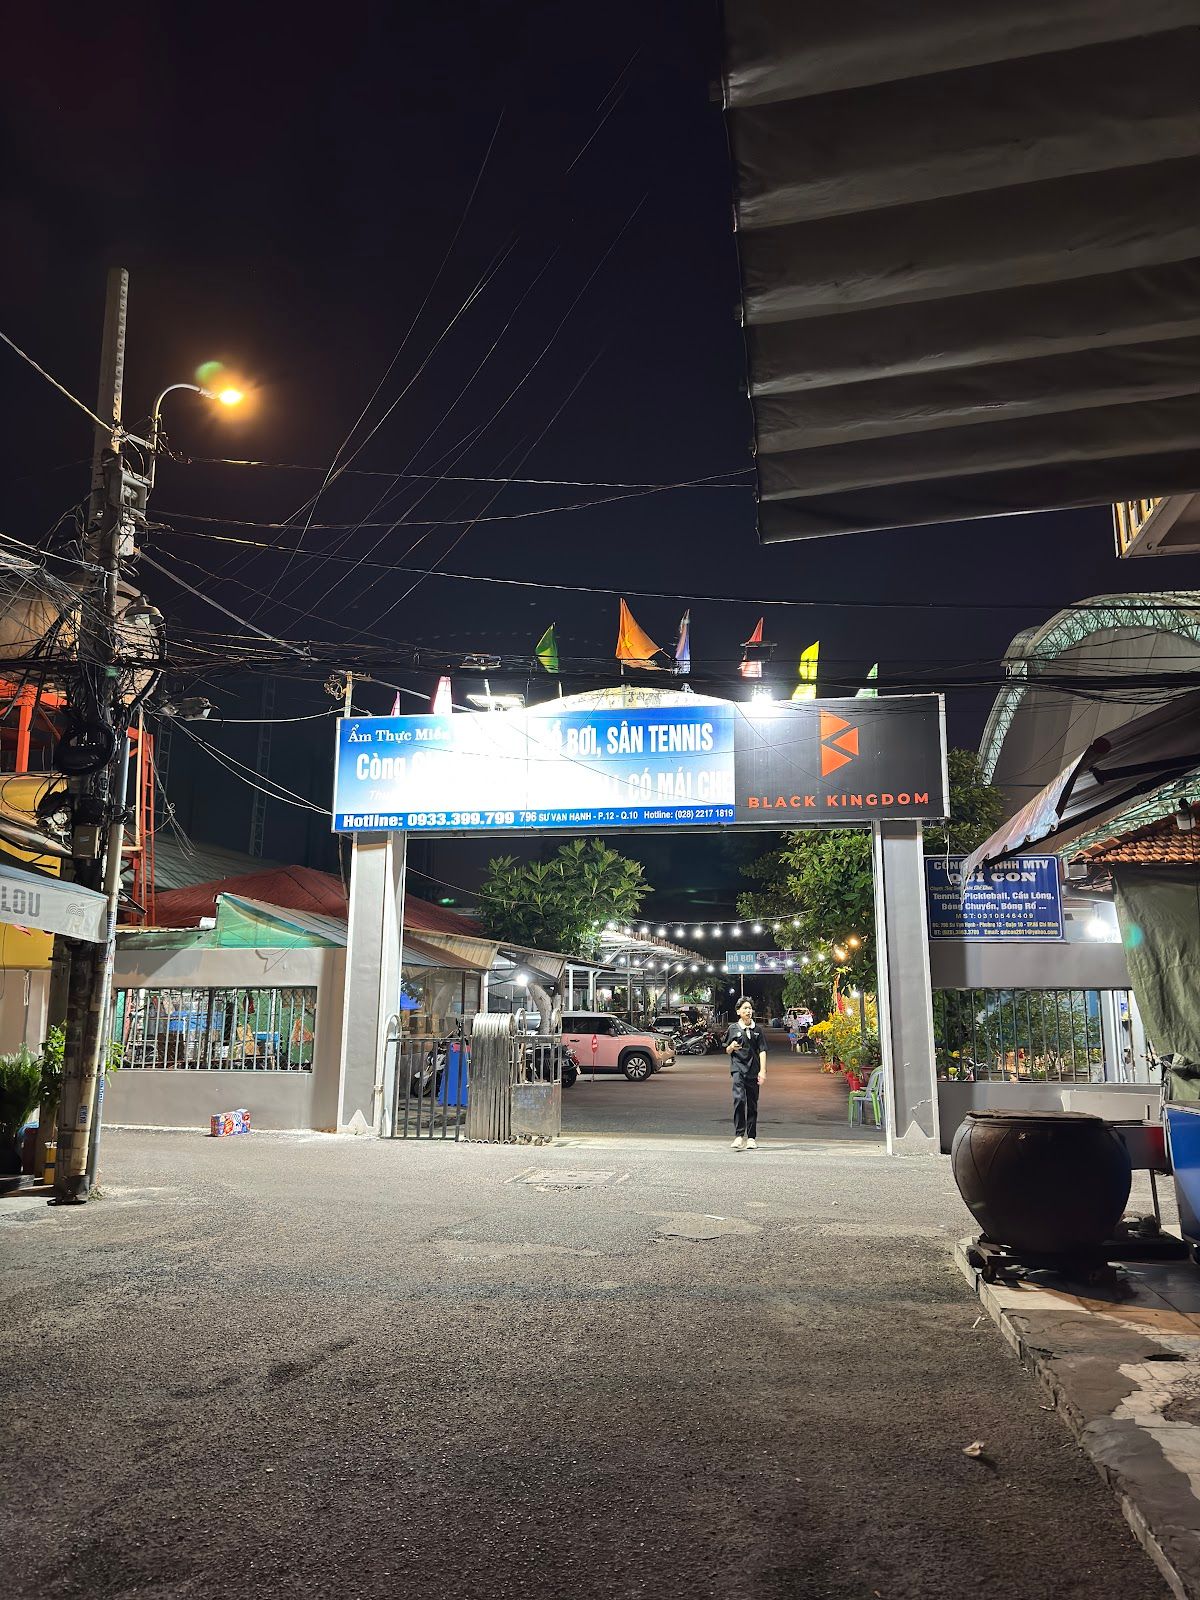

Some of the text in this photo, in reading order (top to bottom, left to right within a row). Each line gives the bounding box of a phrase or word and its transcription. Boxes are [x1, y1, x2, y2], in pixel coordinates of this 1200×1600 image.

[348, 723, 373, 743] Ẩm
[375, 729, 413, 743] Thực
[606, 720, 643, 755] SÂN
[649, 722, 713, 753] TENNIS
[657, 767, 692, 801] MÁI
[748, 792, 930, 809] BLACK KINGDOM
[342, 811, 515, 828] Hotline: 0933.399.799
[519, 811, 537, 823] 796
[539, 812, 550, 822] SƯ
[551, 812, 568, 823] VẠN
[569, 812, 592, 823] HẠNH
[598, 812, 615, 821] P.12
[620, 811, 638, 820] Q.10
[644, 810, 673, 819] Hotline:
[675, 809, 694, 820] (028)
[695, 809, 713, 818] 2217
[933, 859, 962, 870] CÔN
[1022, 859, 1049, 870] MTV
[990, 871, 1037, 882] CON
[964, 892, 1010, 901] Pickleball,
[1030, 890, 1055, 901] Lông,
[941, 902, 963, 911] Bóng
[1001, 901, 1023, 911] Bóng
